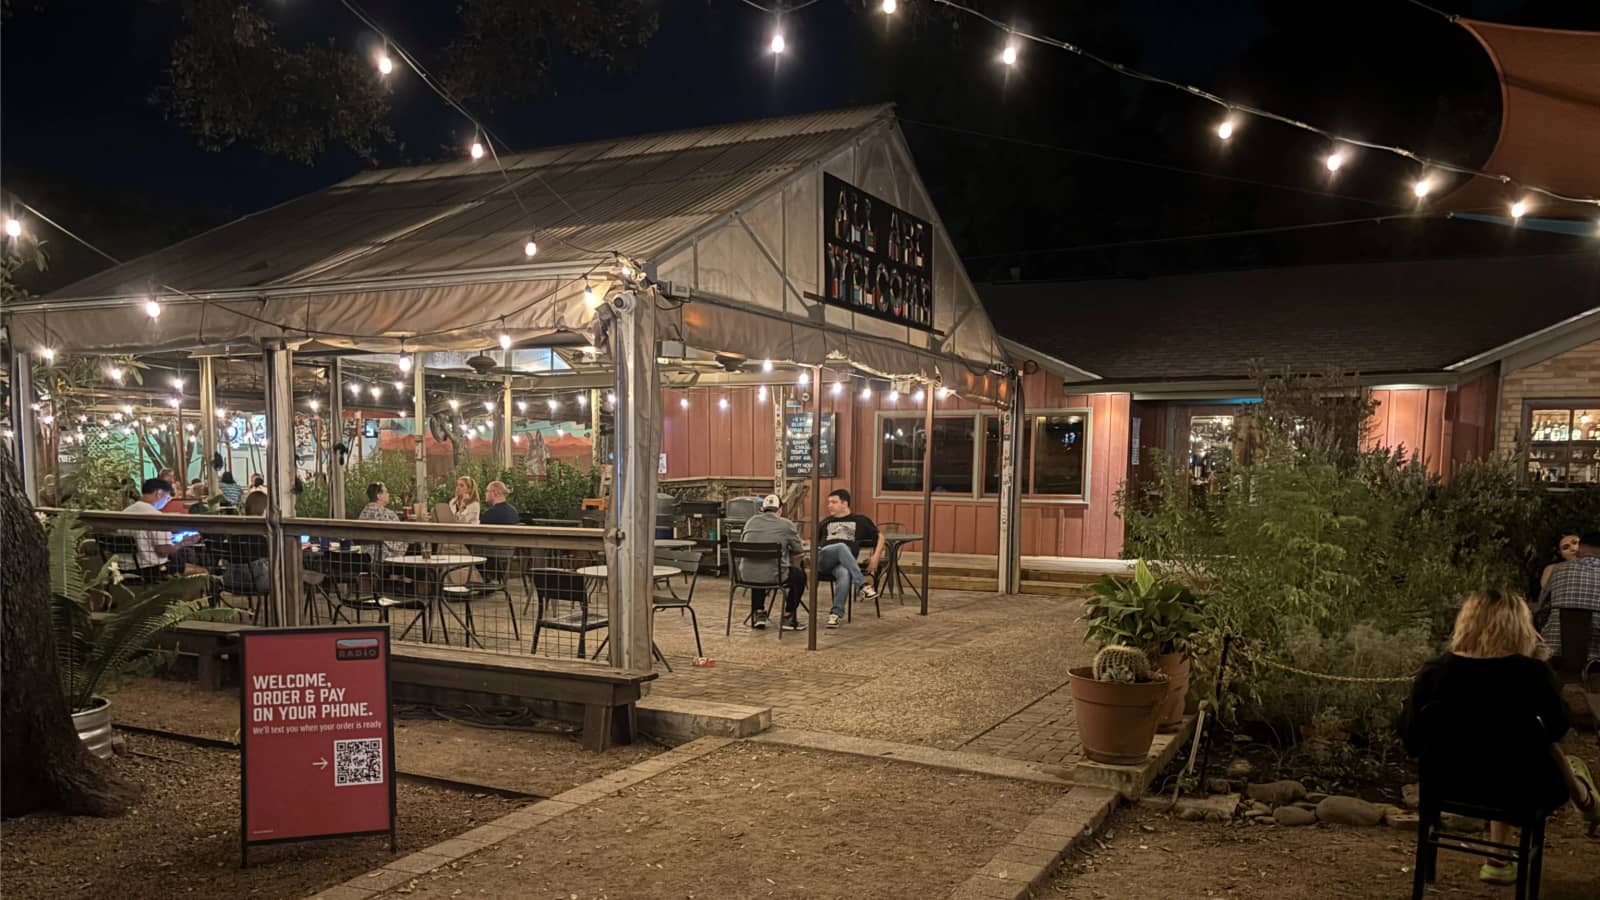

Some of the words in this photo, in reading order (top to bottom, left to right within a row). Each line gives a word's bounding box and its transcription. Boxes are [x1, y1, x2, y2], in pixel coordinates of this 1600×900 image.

[253, 673, 331, 689] WELCOME,
[253, 690, 300, 705] ORDER
[305, 689, 315, 704] &
[320, 688, 345, 702] PAY
[253, 707, 273, 722] ON
[279, 705, 316, 720] YOUR
[321, 703, 373, 718] PHONE.
[252, 725, 270, 735] We'll
[271, 724, 285, 734] text
[286, 725, 299, 735] you
[300, 723, 319, 732] when
[319, 723, 336, 733] your
[336, 720, 355, 730] order
[356, 720, 362, 729] is
[363, 719, 382, 730] ready
